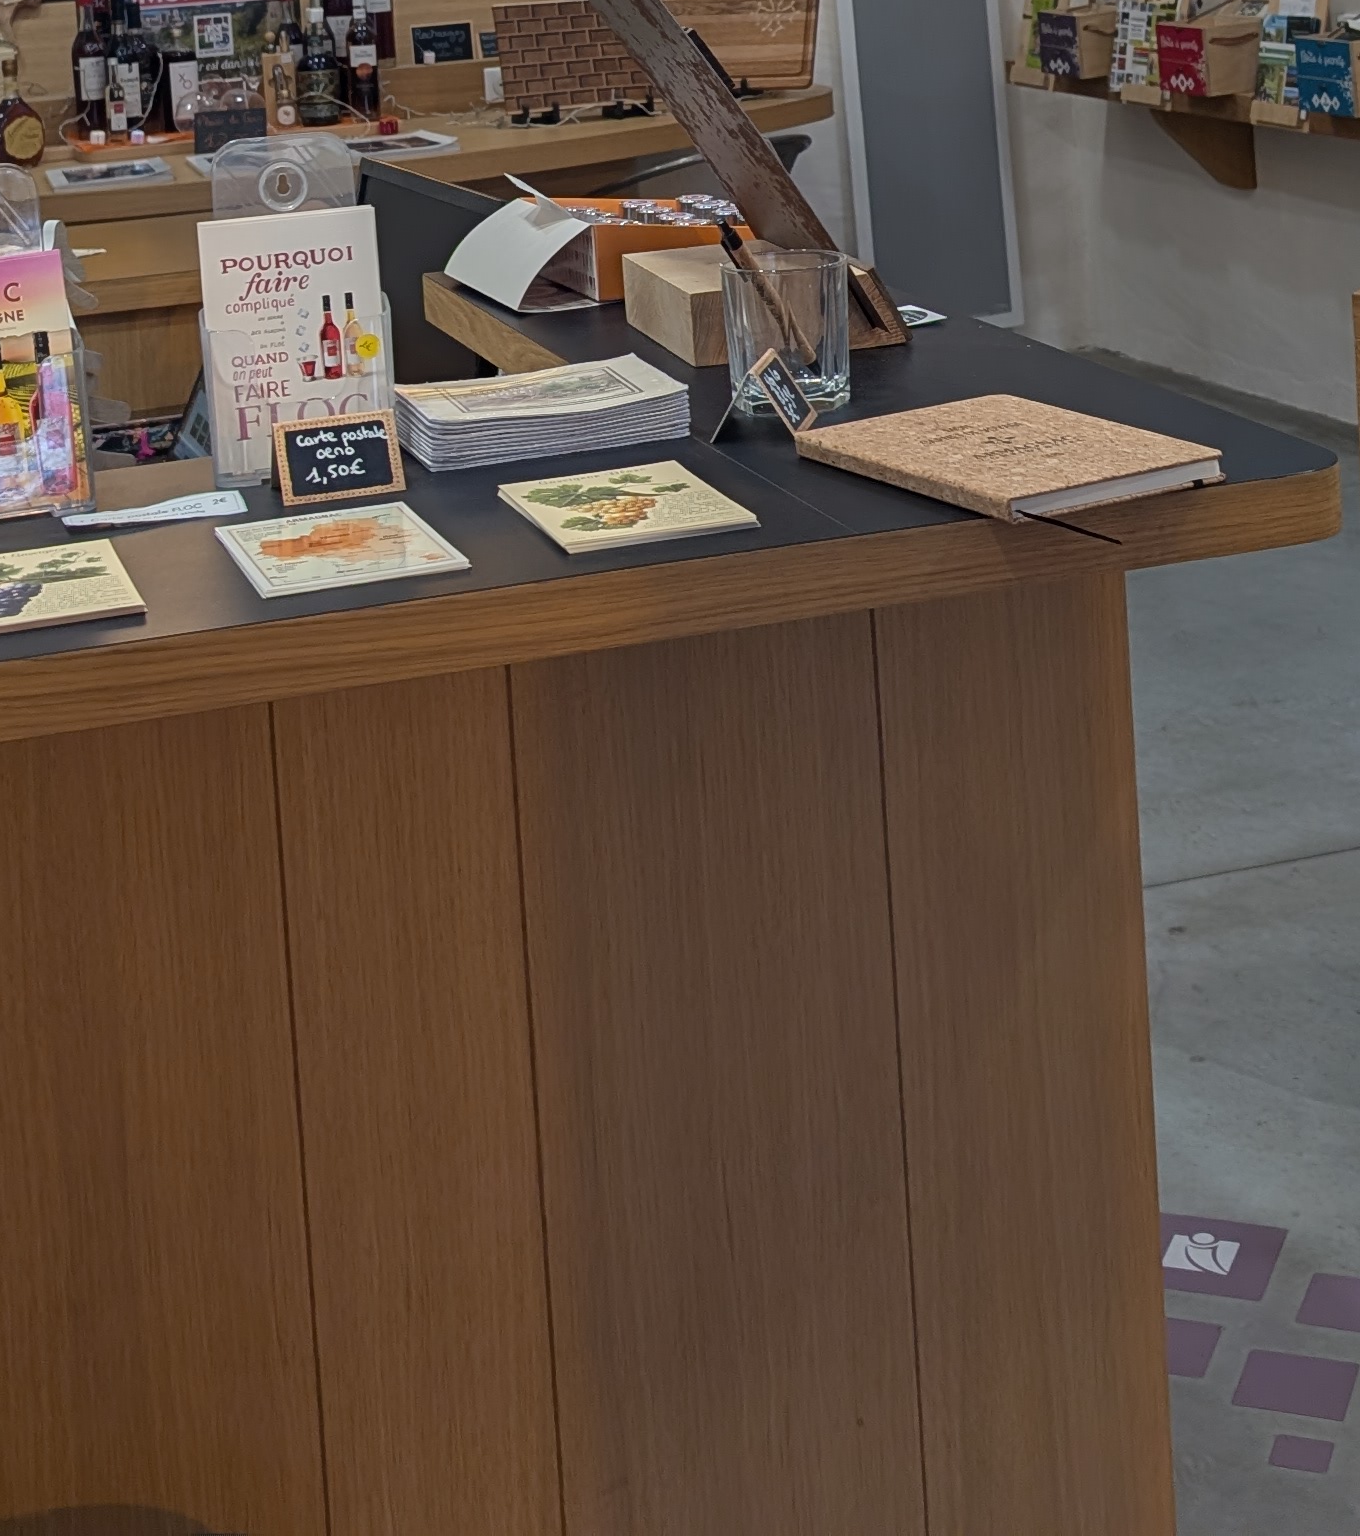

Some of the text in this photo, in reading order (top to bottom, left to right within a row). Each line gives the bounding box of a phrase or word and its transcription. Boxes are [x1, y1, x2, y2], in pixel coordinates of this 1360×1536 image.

[220, 245, 354, 275] POURQUOI
[239, 269, 311, 302] faire
[225, 293, 295, 315] compliqué
[231, 351, 290, 369] QUAND
[232, 366, 273, 384] on peut
[233, 378, 292, 404] FAIRE
[295, 423, 390, 448] Carte postale
[316, 444, 356, 461] oeno
[304, 457, 367, 486] 1,50€
[171, 501, 203, 514] FLOC
[212, 495, 228, 506] 2€
